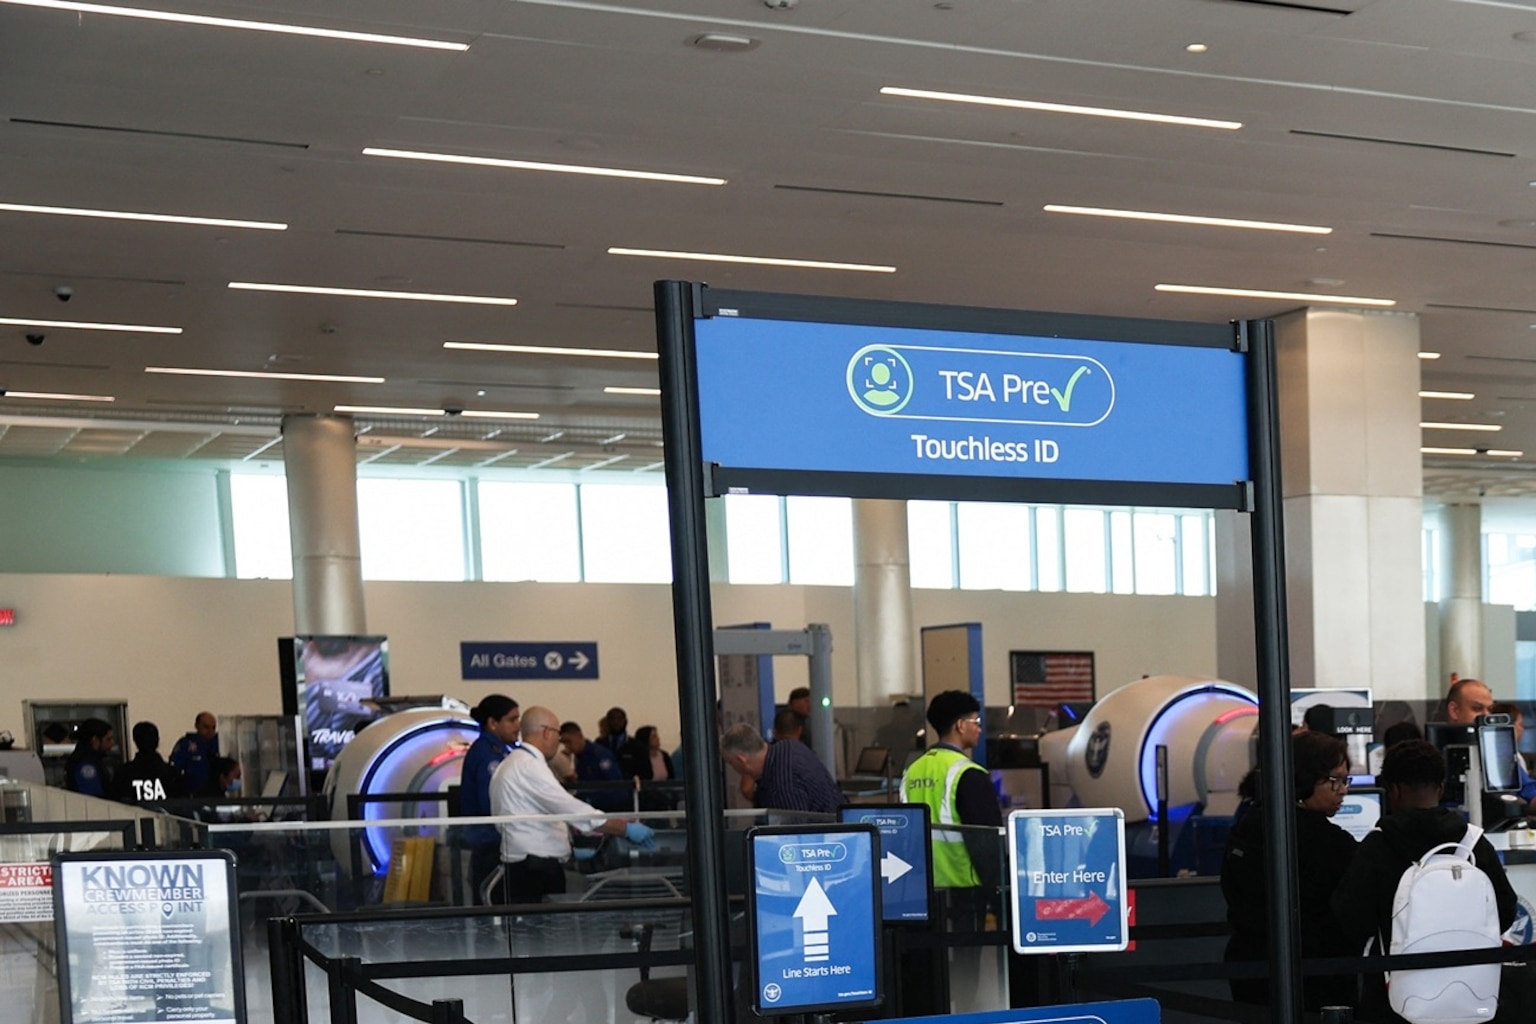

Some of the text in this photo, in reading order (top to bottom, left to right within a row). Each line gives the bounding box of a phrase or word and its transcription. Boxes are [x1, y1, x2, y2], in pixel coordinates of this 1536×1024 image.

[938, 369, 1050, 405] TSA Pre
[911, 434, 1059, 463] Touchless ID
[470, 653, 537, 668] All Gates
[311, 728, 355, 744] TRAVE
[1336, 726, 1372, 734] LOOK HERE
[132, 778, 167, 801] TSA
[1039, 824, 1083, 837] TSA Pre
[801, 848, 830, 858] TSA Pre
[0, 866, 52, 877] STRICT
[795, 863, 831, 872] Touchless ID
[81, 864, 203, 889] KNOWN
[1033, 871, 1105, 884] Enter Here
[84, 888, 202, 902] CREWMEMBER
[87, 902, 146, 915] ACCESS
[782, 965, 851, 979] Line Starts Here
